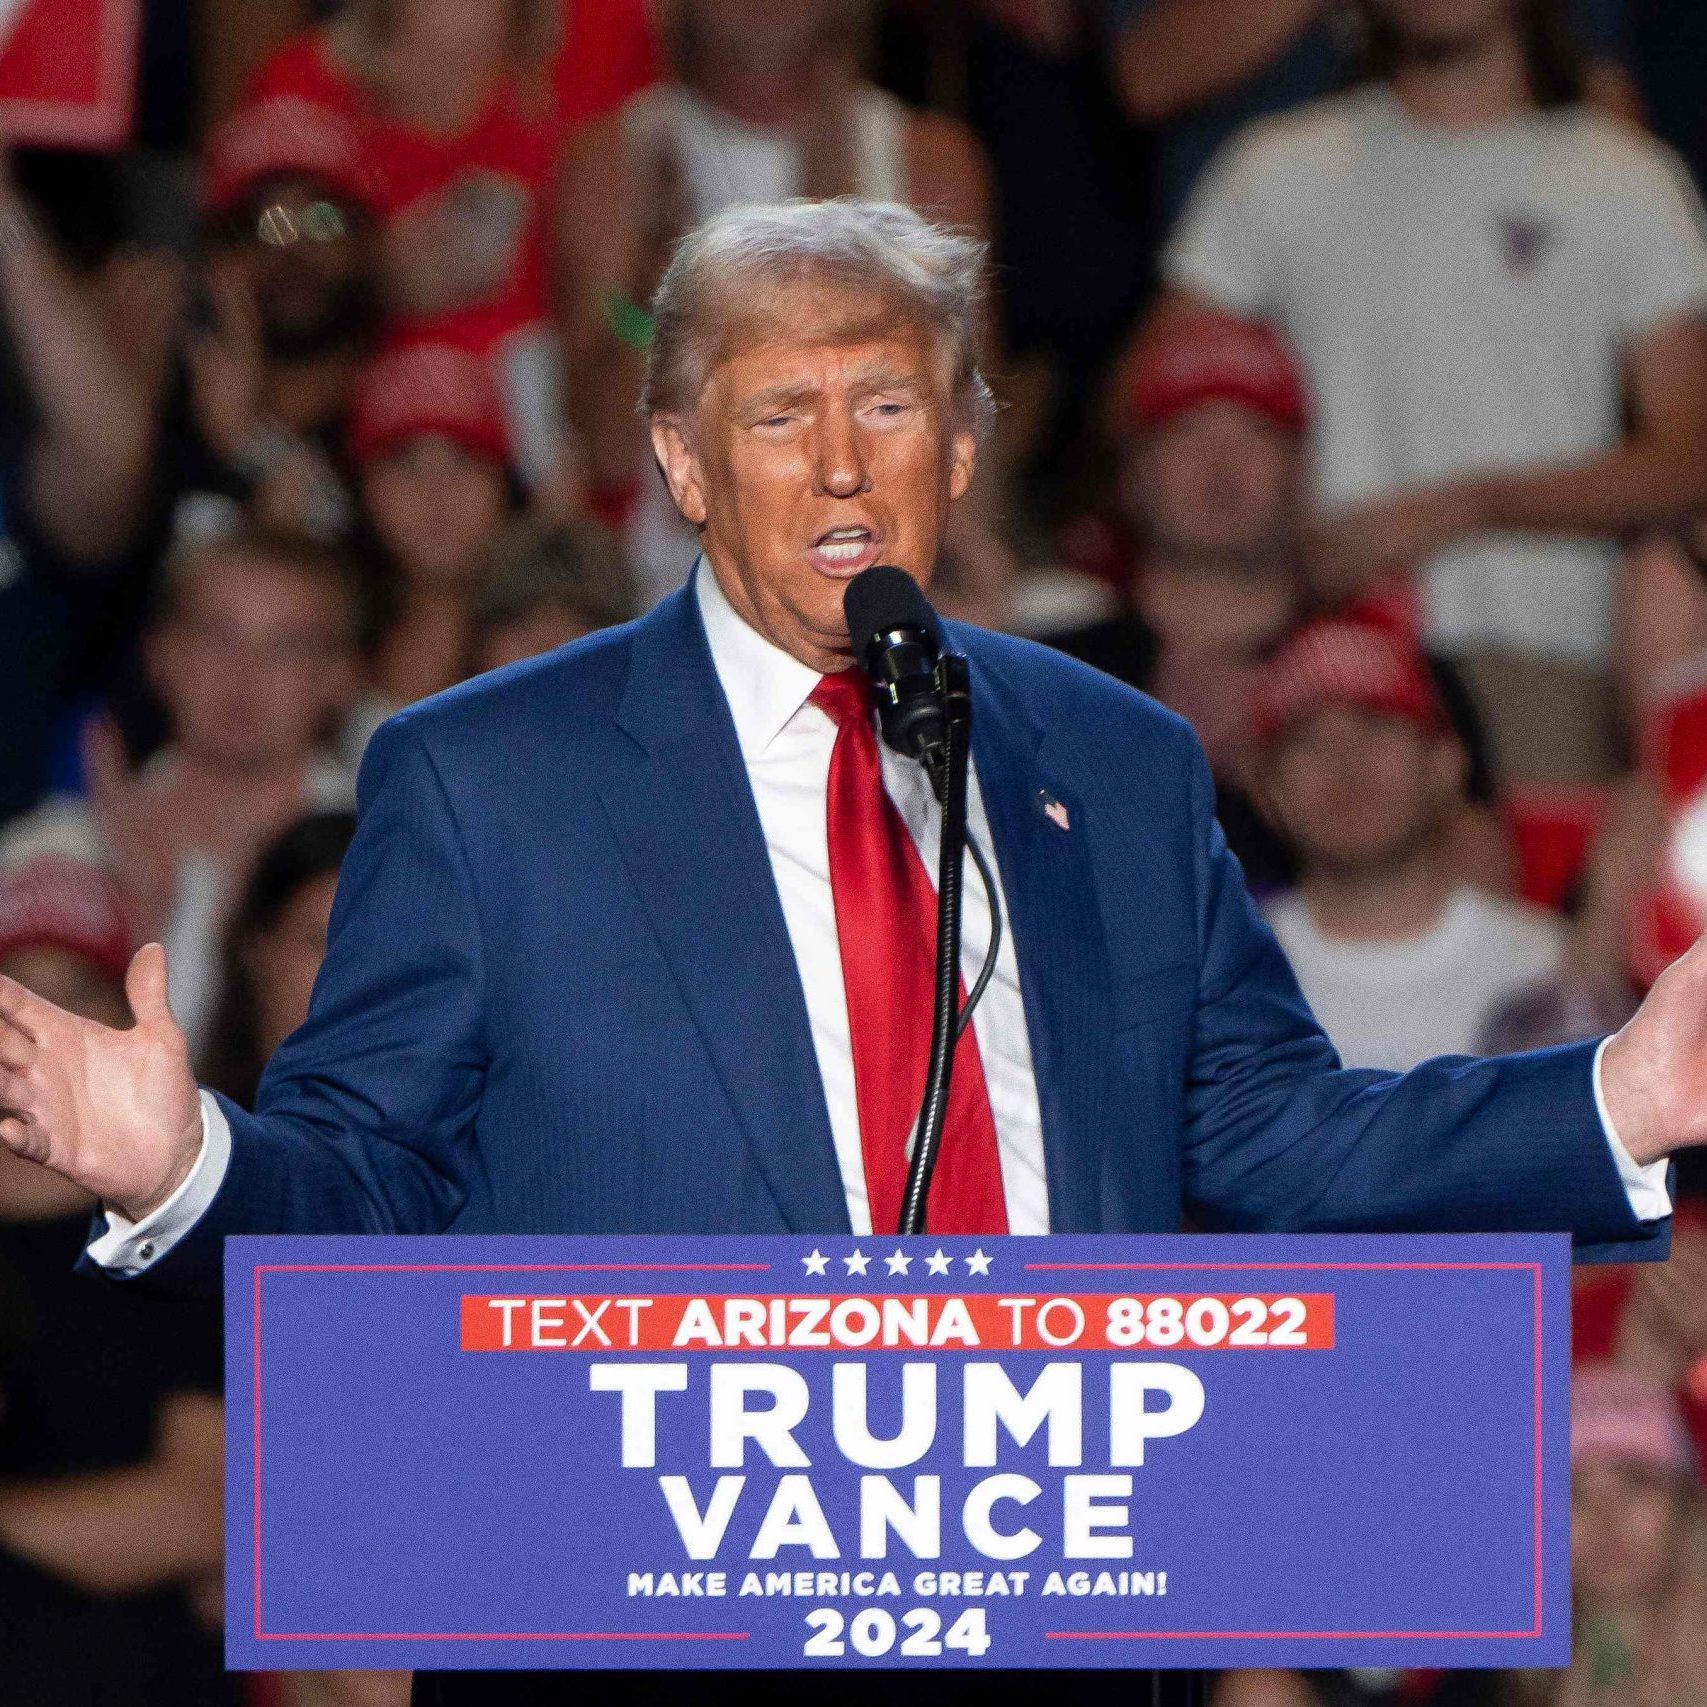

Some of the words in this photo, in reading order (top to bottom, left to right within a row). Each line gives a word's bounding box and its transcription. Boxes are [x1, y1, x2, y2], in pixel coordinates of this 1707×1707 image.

[488, 1299, 653, 1347] TEXT
[672, 1298, 981, 1347] ARIZONA
[998, 1297, 1085, 1347] TO
[1105, 1297, 1307, 1347] 88022
[589, 1361, 1206, 1470] TRUMP
[658, 1473, 1134, 1561] VANCE
[627, 1572, 727, 1597] MAKE
[738, 1571, 902, 1597] AMERICA
[913, 1571, 1030, 1597] GREAT
[1041, 1571, 1168, 1597] AGAIN!
[803, 1607, 991, 1657] 2024
